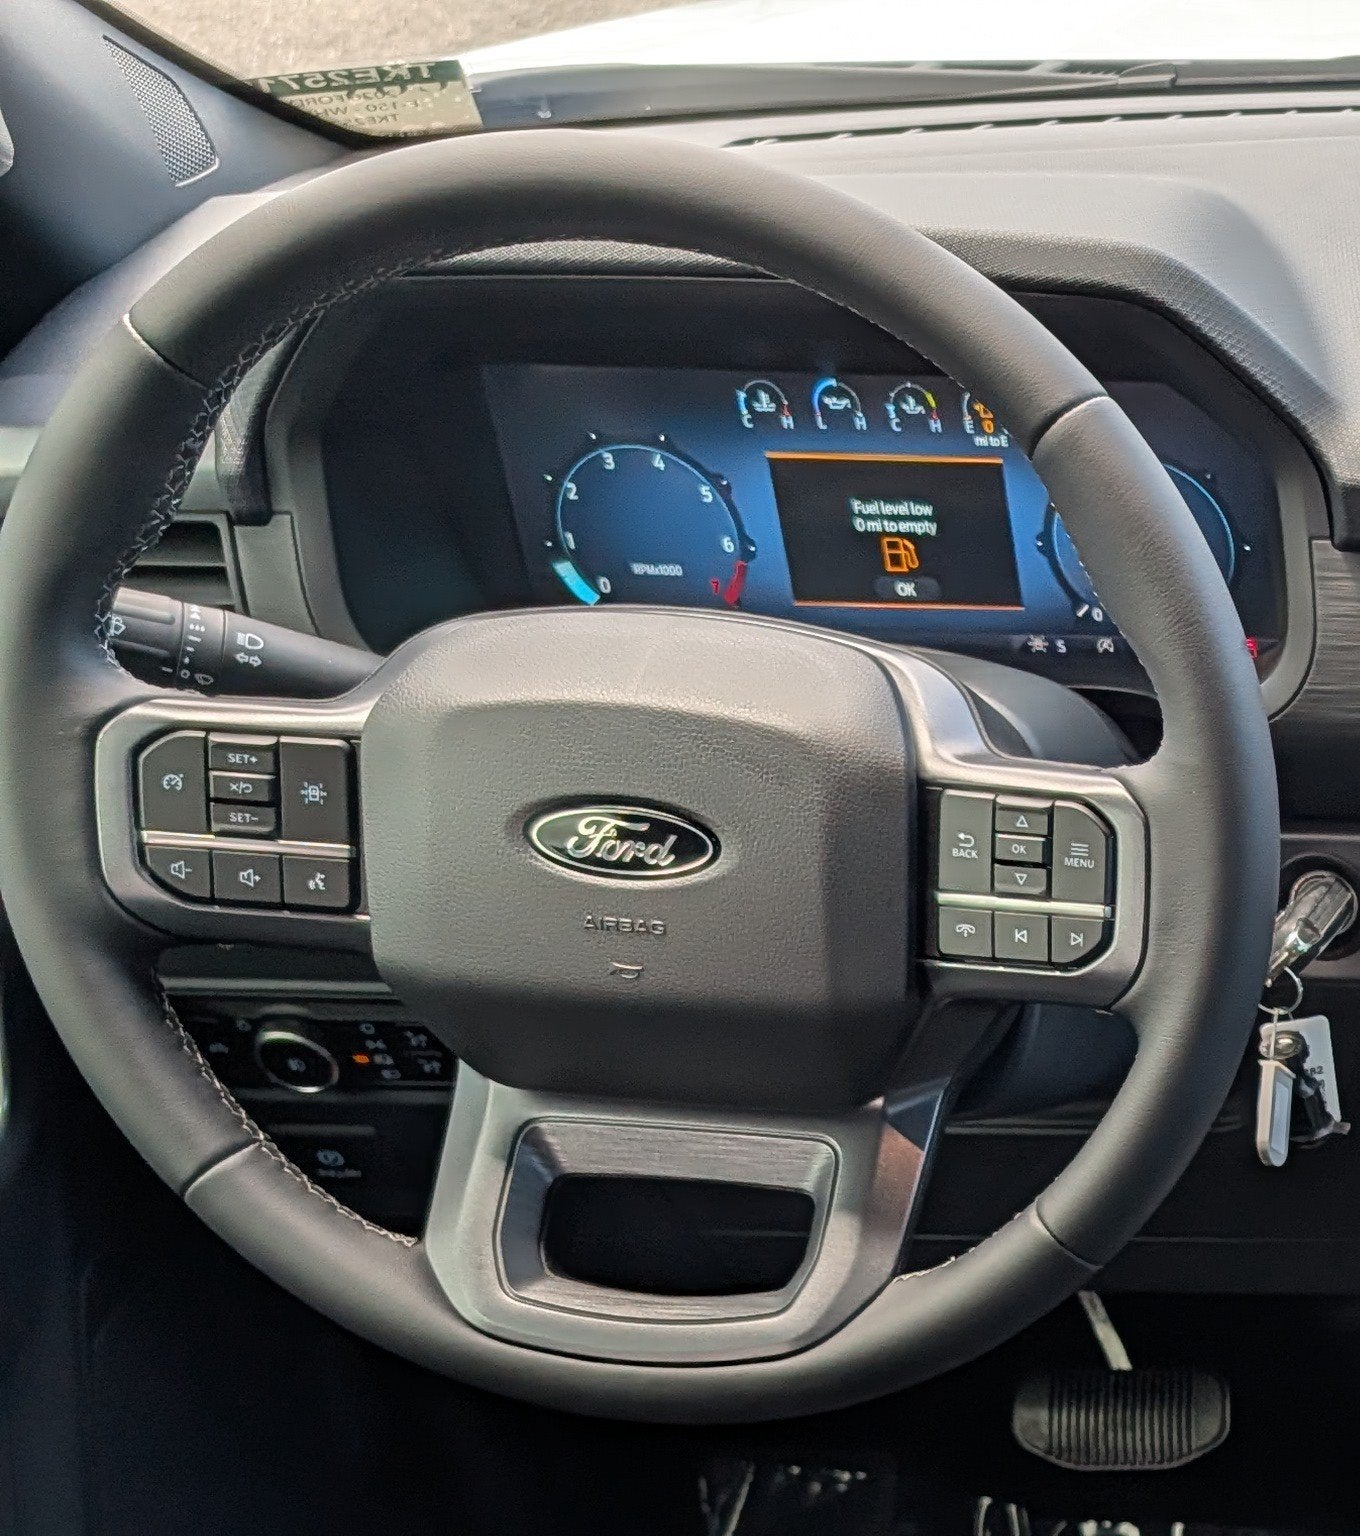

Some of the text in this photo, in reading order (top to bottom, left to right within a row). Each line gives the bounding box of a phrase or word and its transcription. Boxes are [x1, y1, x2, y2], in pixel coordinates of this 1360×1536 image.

[780, 415, 794, 429] H
[853, 415, 867, 430] H
[928, 418, 942, 433] H
[602, 452, 616, 470] 3
[652, 453, 665, 471] 4
[565, 482, 579, 501] 2
[699, 484, 713, 503] 5
[850, 499, 933, 516] Fuel level low
[853, 517, 937, 536] 0 mi to empty
[564, 531, 575, 550] 1
[721, 536, 734, 553] 6
[599, 576, 611, 594] 0
[894, 580, 917, 597] OK
[567, 816, 678, 867] Ford
[1011, 844, 1027, 854] OK
[952, 847, 978, 859] BACK
[1064, 857, 1095, 869] MENU
[584, 915, 667, 936] AIRBAG
